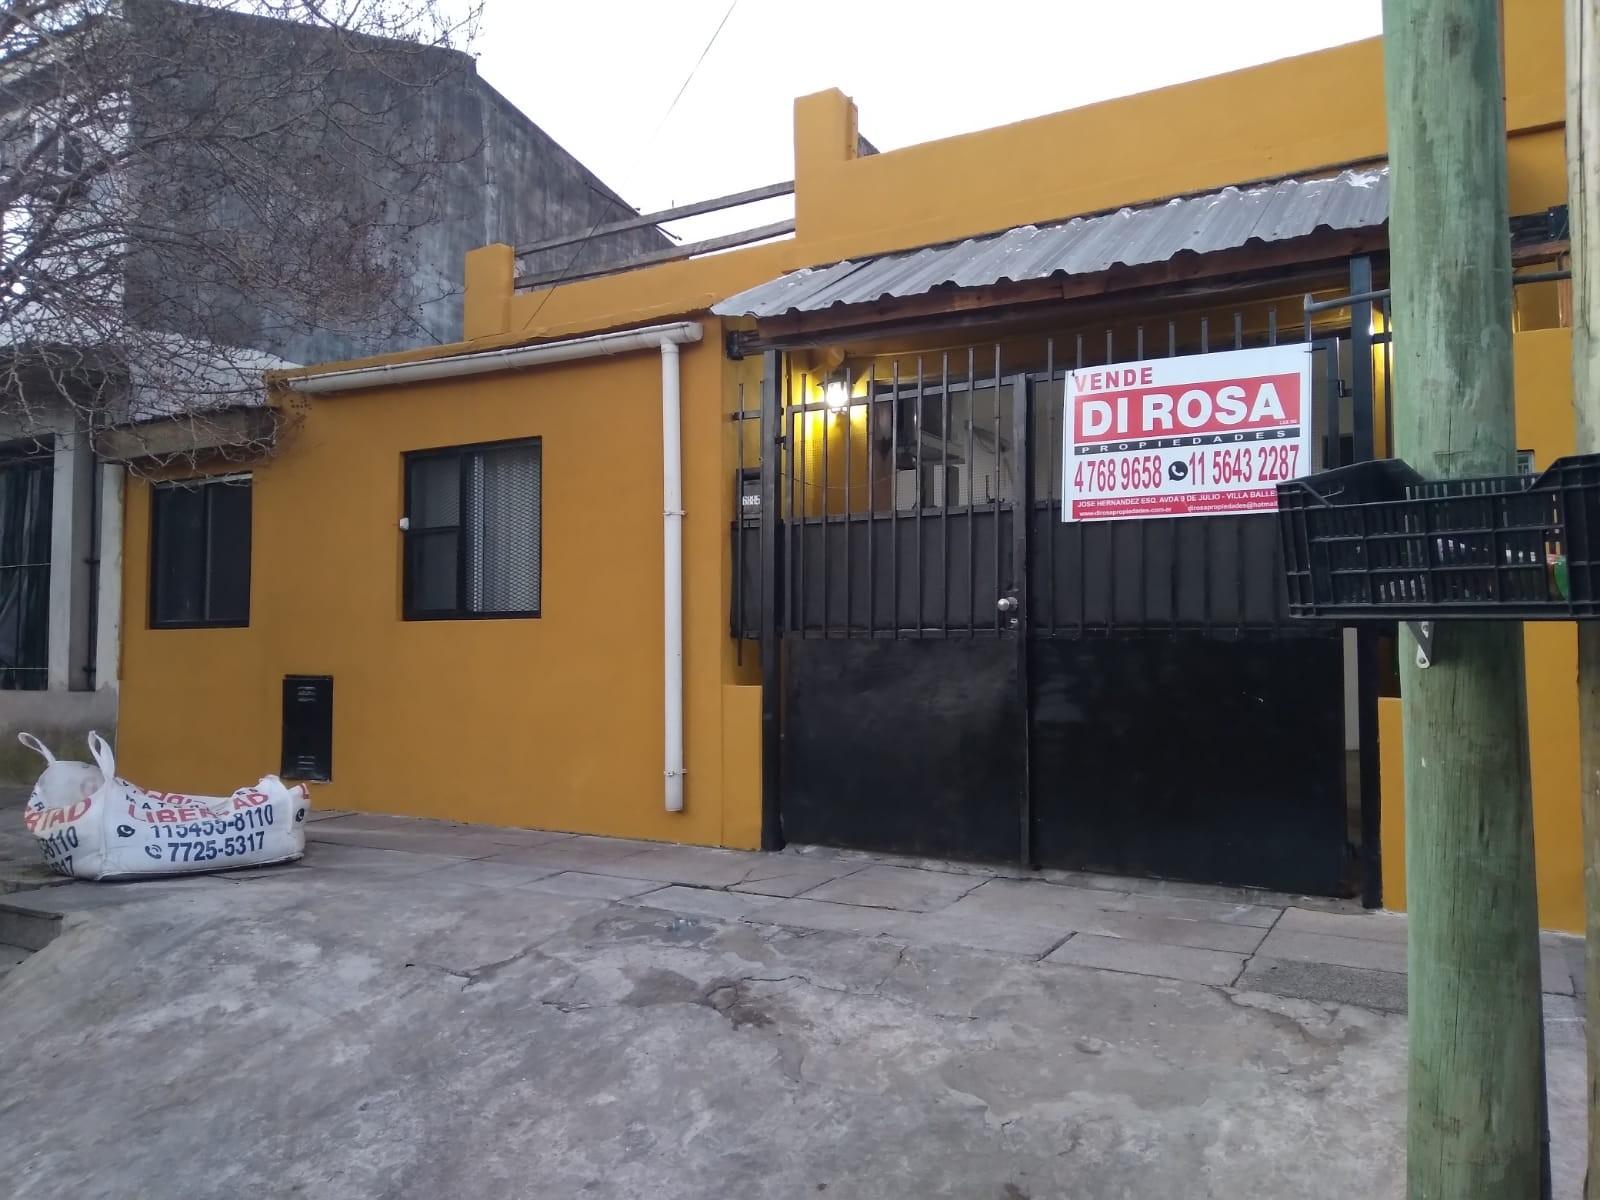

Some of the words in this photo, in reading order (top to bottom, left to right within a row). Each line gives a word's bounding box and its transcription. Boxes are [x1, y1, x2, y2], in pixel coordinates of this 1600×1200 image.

[1075, 367, 1153, 393] VENDE
[1082, 397, 1128, 437] DI
[1142, 383, 1286, 432] ROSA
[1081, 430, 1286, 455] PROPIEDADES
[1121, 455, 1162, 491] 9658
[1189, 451, 1205, 486] 11
[1212, 448, 1251, 485] 5643
[1258, 444, 1299, 482] 2287
[1097, 497, 1140, 507] HERNANDEZ
[1198, 493, 1220, 501] JULIO
[1226, 491, 1249, 500] VILLA
[1250, 489, 1277, 499] BALLE
[167, 831, 265, 863] 7725-5317
